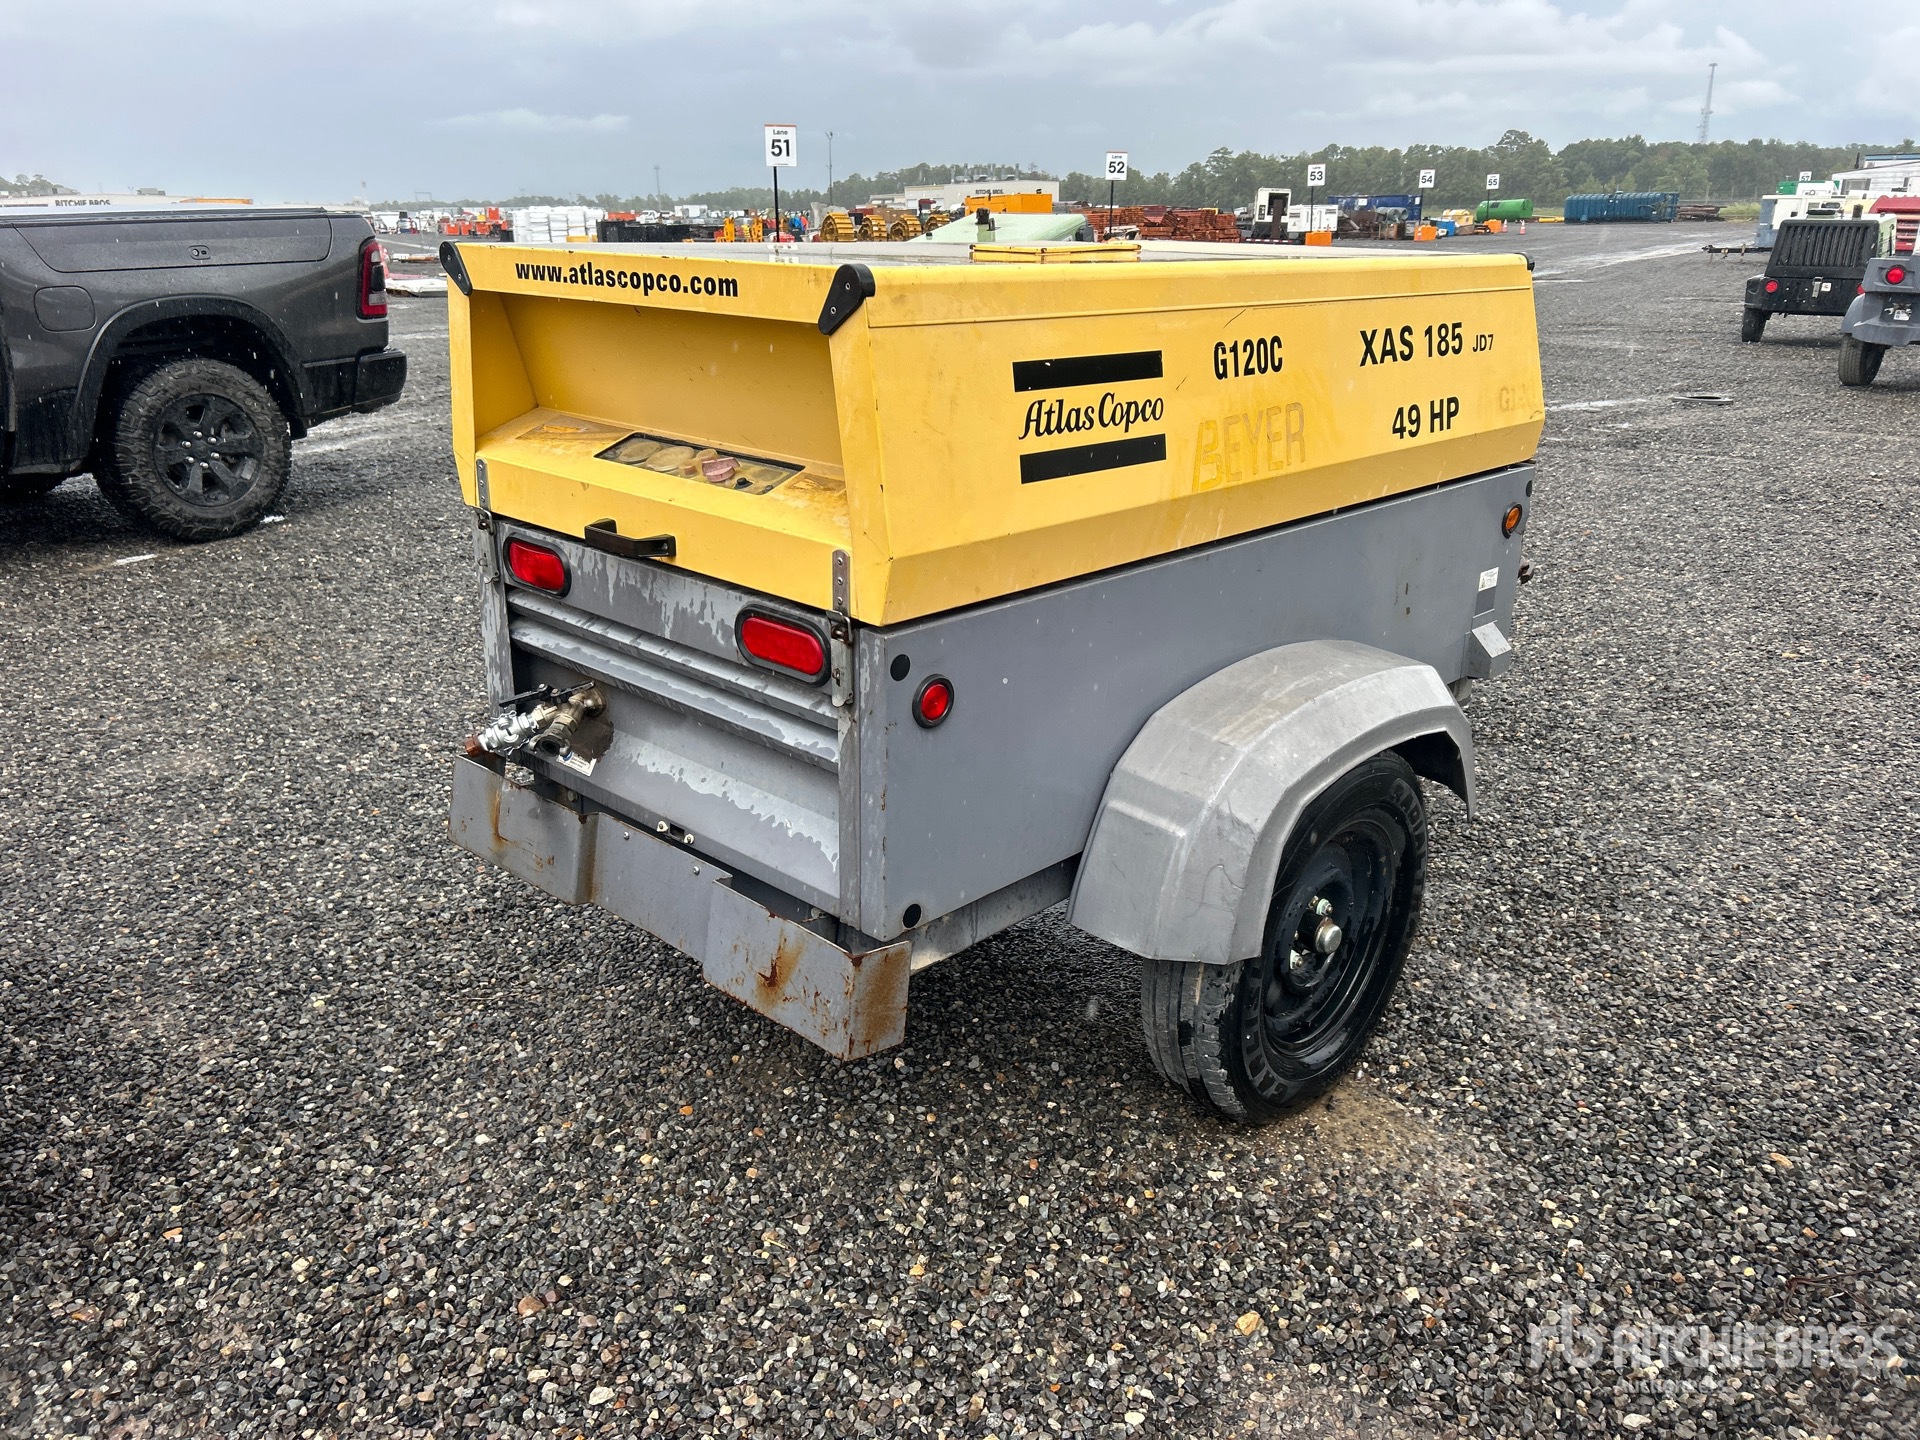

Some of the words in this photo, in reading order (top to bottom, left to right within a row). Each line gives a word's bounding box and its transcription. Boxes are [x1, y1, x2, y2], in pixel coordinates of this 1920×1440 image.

[771, 139, 790, 157] 51
[1108, 161, 1125, 174] 52
[1310, 171, 1323, 181] 53
[1421, 175, 1433, 184] 54
[1488, 178, 1498, 186] 55
[515, 261, 739, 297] www.atlascopco.com
[1213, 335, 1284, 380] G120C
[1359, 325, 1414, 367] XAS
[1424, 322, 1463, 358] 185
[1472, 334, 1494, 352] JD7
[1018, 398, 1095, 440] Atlas
[1098, 392, 1164, 433] Copco
[1392, 404, 1421, 439] 49
[1429, 396, 1460, 433] HP
[1191, 402, 1306, 493] BEYER
